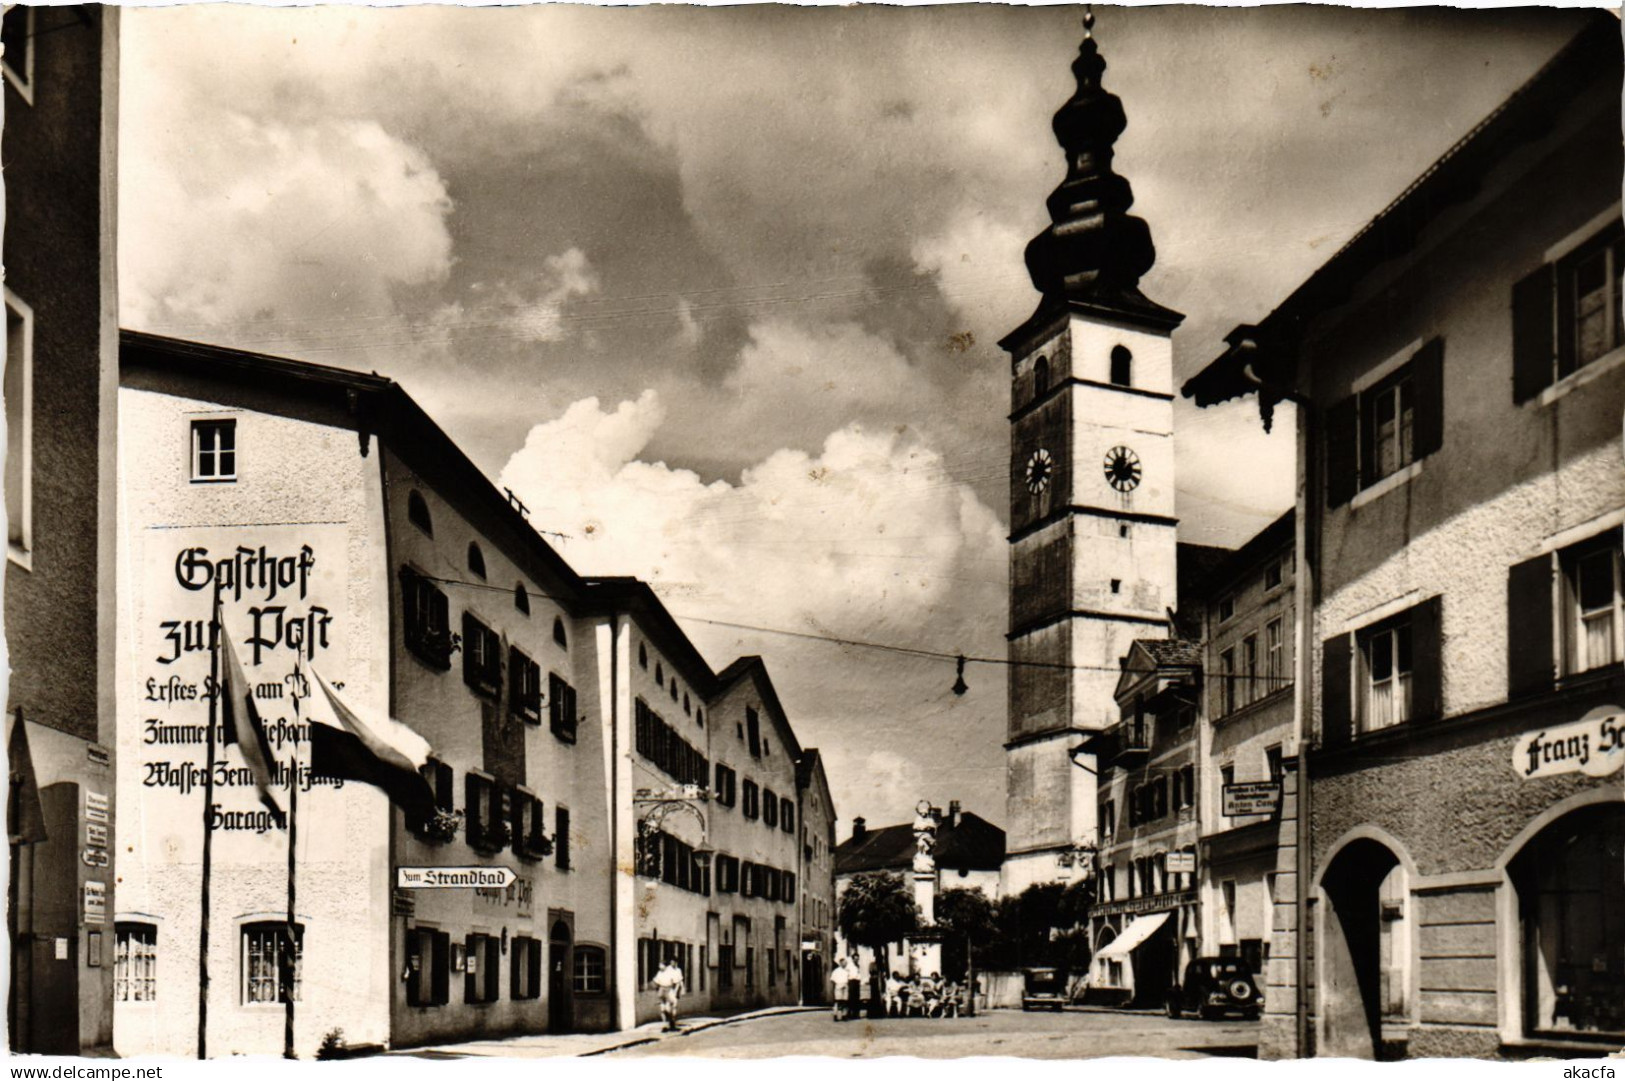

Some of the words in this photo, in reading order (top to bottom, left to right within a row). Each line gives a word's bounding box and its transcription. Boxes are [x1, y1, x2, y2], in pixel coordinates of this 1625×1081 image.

[175, 544, 316, 602] Gasthof
[156, 620, 222, 665] zur
[244, 605, 333, 666] Post
[145, 675, 197, 709] Erstes
[256, 682, 284, 700] am
[1525, 731, 1590, 776] Franz
[424, 871, 505, 885] Strandbad
